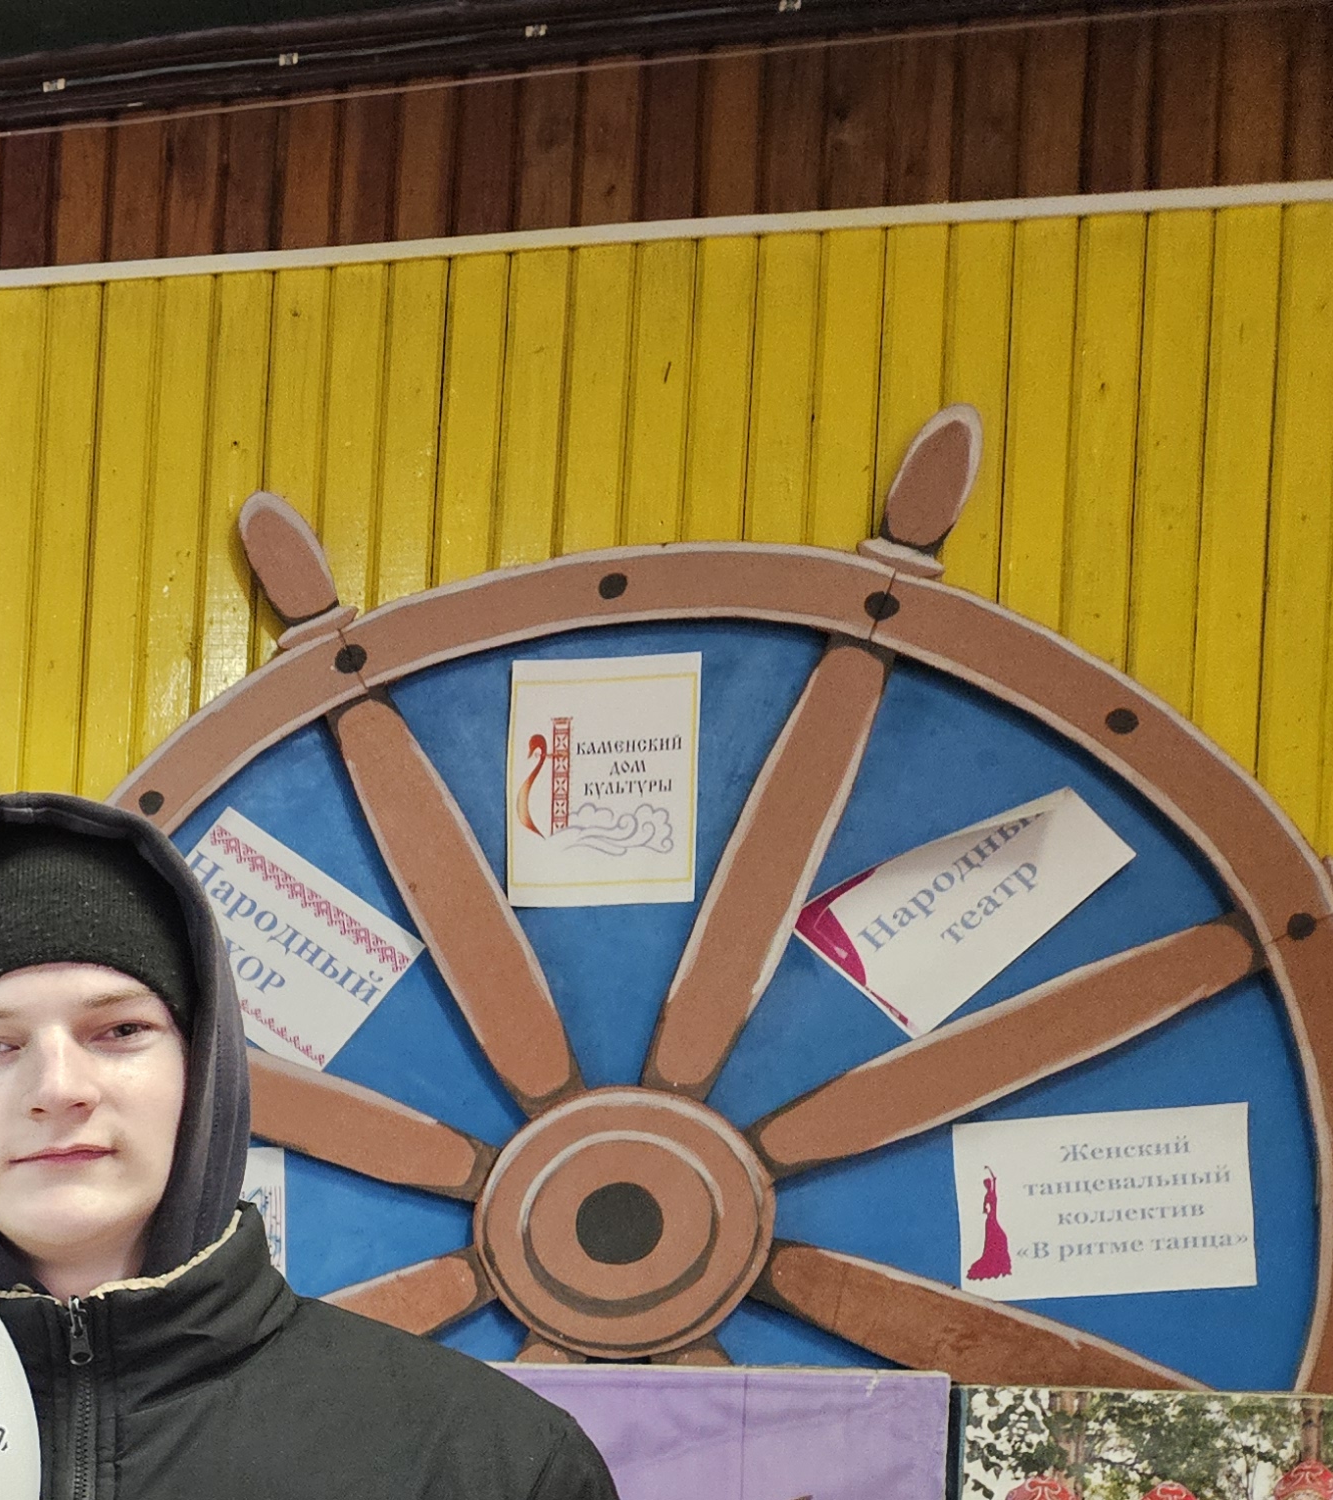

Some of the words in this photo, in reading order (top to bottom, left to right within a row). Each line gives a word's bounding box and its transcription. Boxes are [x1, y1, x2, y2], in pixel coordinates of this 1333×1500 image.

[609, 759, 646, 776] ДОМ
[583, 779, 672, 799] КУЛЬТУРЫ
[857, 812, 1044, 952] Народны
[940, 862, 1038, 945] театр
[189, 850, 384, 1006] Народный
[1060, 1136, 1191, 1164] Женский
[1023, 1164, 1231, 1197] танцевальный
[1057, 1203, 1205, 1226] коллектив
[1059, 1239, 1145, 1263] ритме
[1151, 1233, 1248, 1253] танца»
